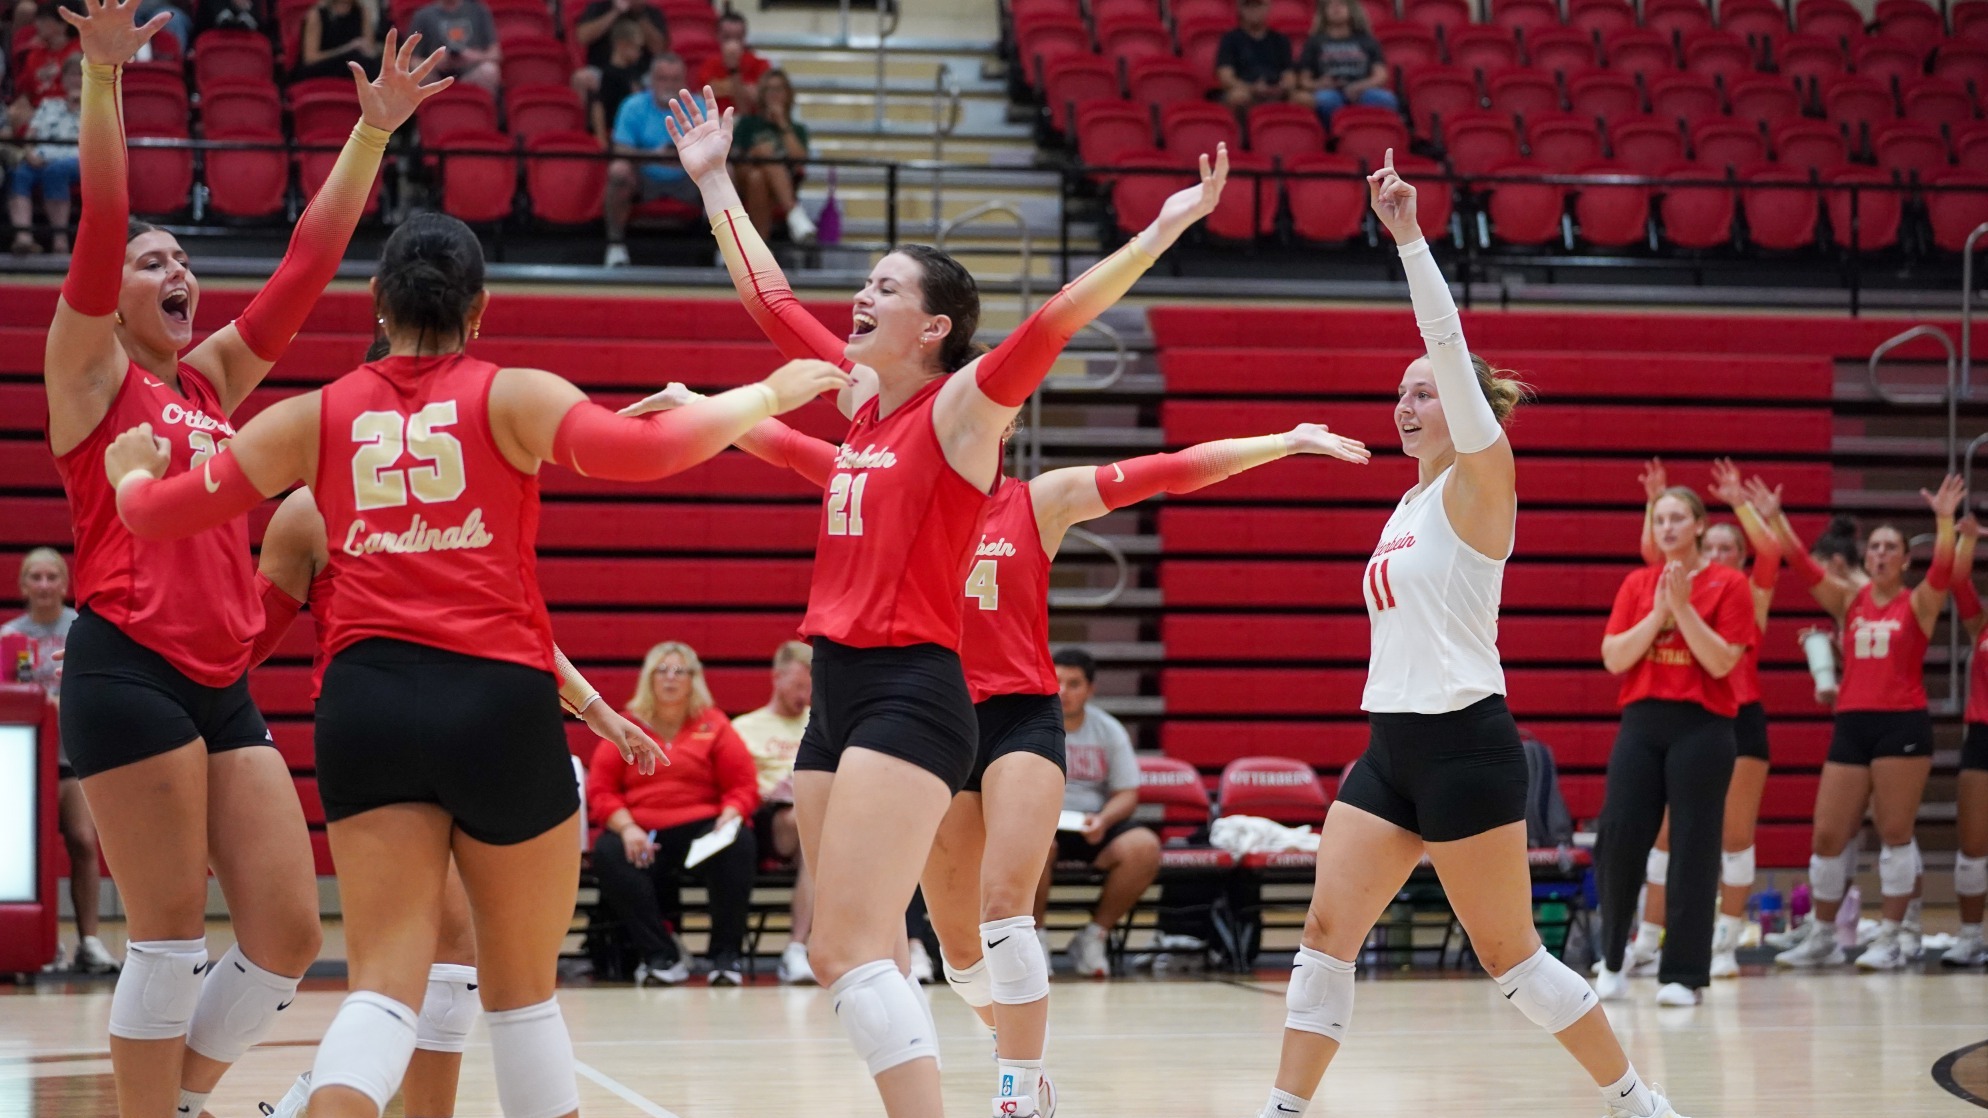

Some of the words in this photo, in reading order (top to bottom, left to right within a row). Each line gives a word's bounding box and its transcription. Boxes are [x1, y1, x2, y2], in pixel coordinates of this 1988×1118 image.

[352, 399, 466, 511] 25
[343, 507, 494, 557] Cardinals
[828, 472, 868, 536] 21
[1369, 558, 1397, 612] 11
